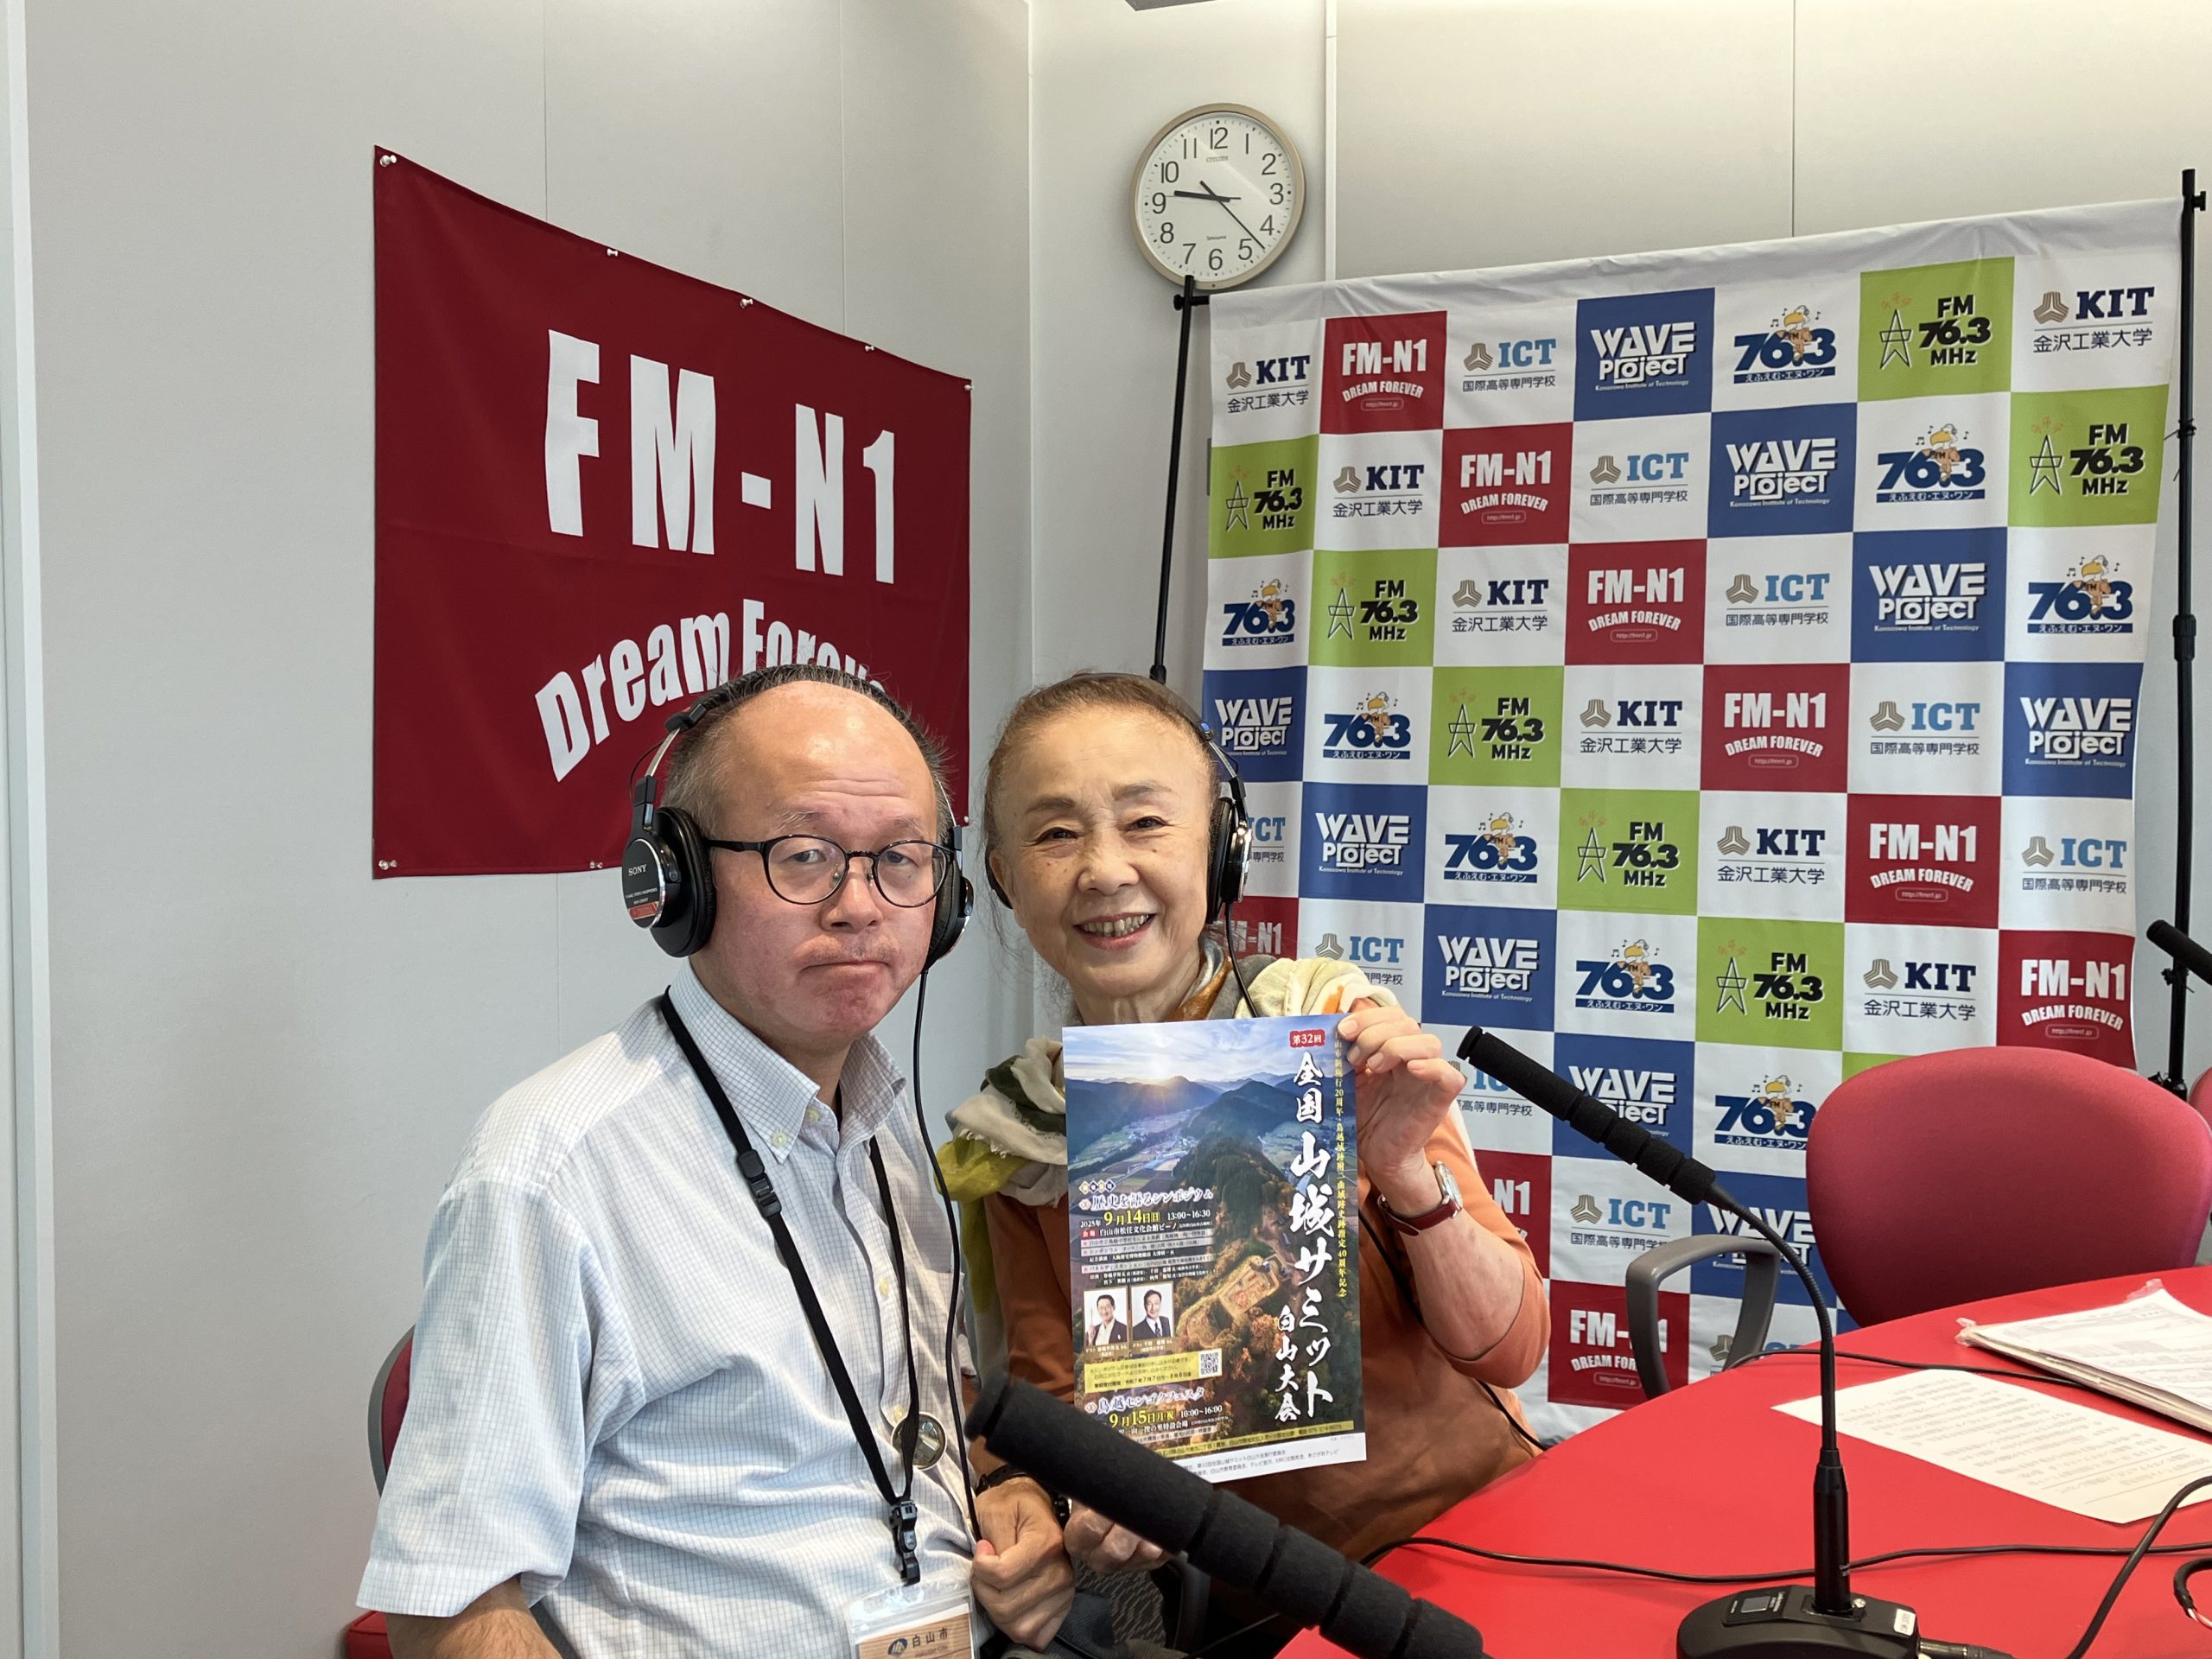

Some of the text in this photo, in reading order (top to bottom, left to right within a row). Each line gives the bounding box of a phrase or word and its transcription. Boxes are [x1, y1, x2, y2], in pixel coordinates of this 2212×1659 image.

[1184, 138, 1197, 159] 11
[1211, 128, 1228, 149] 12
[1246, 133, 1249, 154] 1
[1161, 162, 1179, 183] 10
[1262, 154, 1276, 175] 2
[1152, 193, 1166, 213] 9
[1269, 183, 1283, 205] 3
[1160, 222, 1174, 243] 8
[1260, 215, 1274, 235] 4
[1183, 244, 1196, 264] 7
[1209, 249, 1223, 270] 6
[1238, 238, 1252, 260] 5
[1937, 295, 1974, 318] FM
[2076, 287, 2154, 320] KIT
[1591, 322, 1695, 357] WAVE
[1919, 317, 1992, 348] 76.3
[2033, 328, 2152, 353] 金沢工業大学
[1342, 339, 1427, 376] FM-N1
[1498, 339, 1556, 368] ICT
[1931, 347, 1977, 366] MHz
[1256, 355, 1310, 385] KIT
[1343, 379, 1424, 402] DREAM FOREVER
[1463, 375, 1555, 392] 国際高等専門学校
[1227, 390, 1309, 412] 金沢工業大学
[2089, 423, 2128, 445] FM
[545, 329, 895, 585] FM-N1
[1726, 438, 1836, 473] WAVE
[2070, 447, 2145, 475] 76.3
[1366, 465, 1424, 490] KIT
[1460, 451, 1551, 487] FM-N1
[1627, 453, 1689, 481] ICT
[1268, 469, 1294, 488] FM
[2082, 478, 2128, 496] MHz
[1254, 486, 1303, 513] 76.3
[1333, 499, 1422, 517] 金沢工業大学
[1461, 493, 1548, 514] DREAM FOREVER
[1590, 490, 1688, 505] 国際高等専門学校
[1262, 514, 1294, 530] MHz
[1375, 580, 1405, 598] FM
[1588, 568, 1684, 604] FM-N1
[1765, 574, 1830, 602] ICT
[1869, 563, 1986, 596] WAVE
[1488, 580, 1549, 605] KIT
[1361, 601, 1418, 623] 76.3
[1588, 611, 1681, 632] DREAM FOREVER
[1726, 613, 1828, 626] 国際高等専門学校
[1370, 626, 1406, 641] MHz
[1452, 616, 1548, 632] 金沢工業大学
[535, 611, 730, 782] Dream
[1497, 697, 1529, 715] FM
[1216, 696, 1292, 727] WAVE
[1618, 701, 1682, 727] KIT
[1725, 693, 1827, 728] FM-N1
[1911, 702, 1980, 731] ICT
[2021, 697, 2133, 732] WAVE
[1482, 718, 1544, 742] 76.3
[1491, 745, 1531, 760] MHz
[1580, 737, 1681, 753] 金沢工業大学
[1726, 736, 1823, 758] DREAM FOREVER
[1871, 741, 1980, 755] 国際高等専門学校
[1316, 812, 1410, 845] WAVE
[1630, 822, 1663, 842] FM
[1757, 829, 1826, 856] KIT
[1870, 823, 1976, 862] FM-N1
[2062, 838, 2127, 868] ICT
[1250, 852, 1284, 863] 専門学校
[1613, 843, 1679, 868] 76.3
[629, 864, 646, 876] SONY
[1624, 870, 1666, 888] MHz
[1718, 866, 1825, 884] 金沢工業大学
[1870, 868, 1974, 892] DREAM FOREVER
[2023, 878, 2127, 893] 国際高等専門学校
[1223, 920, 1282, 955] M-N1
[1350, 936, 1404, 963] ICT
[1439, 936, 1539, 970] WAVE
[1770, 952, 1807, 974] FM
[1905, 962, 1976, 992] KIT
[2021, 959, 2126, 1001] FM-N1
[1753, 975, 1823, 1002] 76.3
[1765, 1002, 1809, 1020] MHz
[1864, 1000, 1976, 1020] 金沢工業大学
[2021, 1004, 2123, 1032] DREAM FOREVER
[1292, 1033, 1322, 1045] 第32回
[1568, 1065, 1675, 1103] WAVE
[1458, 1100, 1533, 1116] 高等専門学校
[1608, 1198, 1670, 1229] ICT
[1570, 1309, 1668, 1352] FM-1
[1274, 1304, 1300, 1422] 白山大会
[1571, 1355, 1612, 1370] DREAM
[912, 1627, 948, 1648] 白山市
